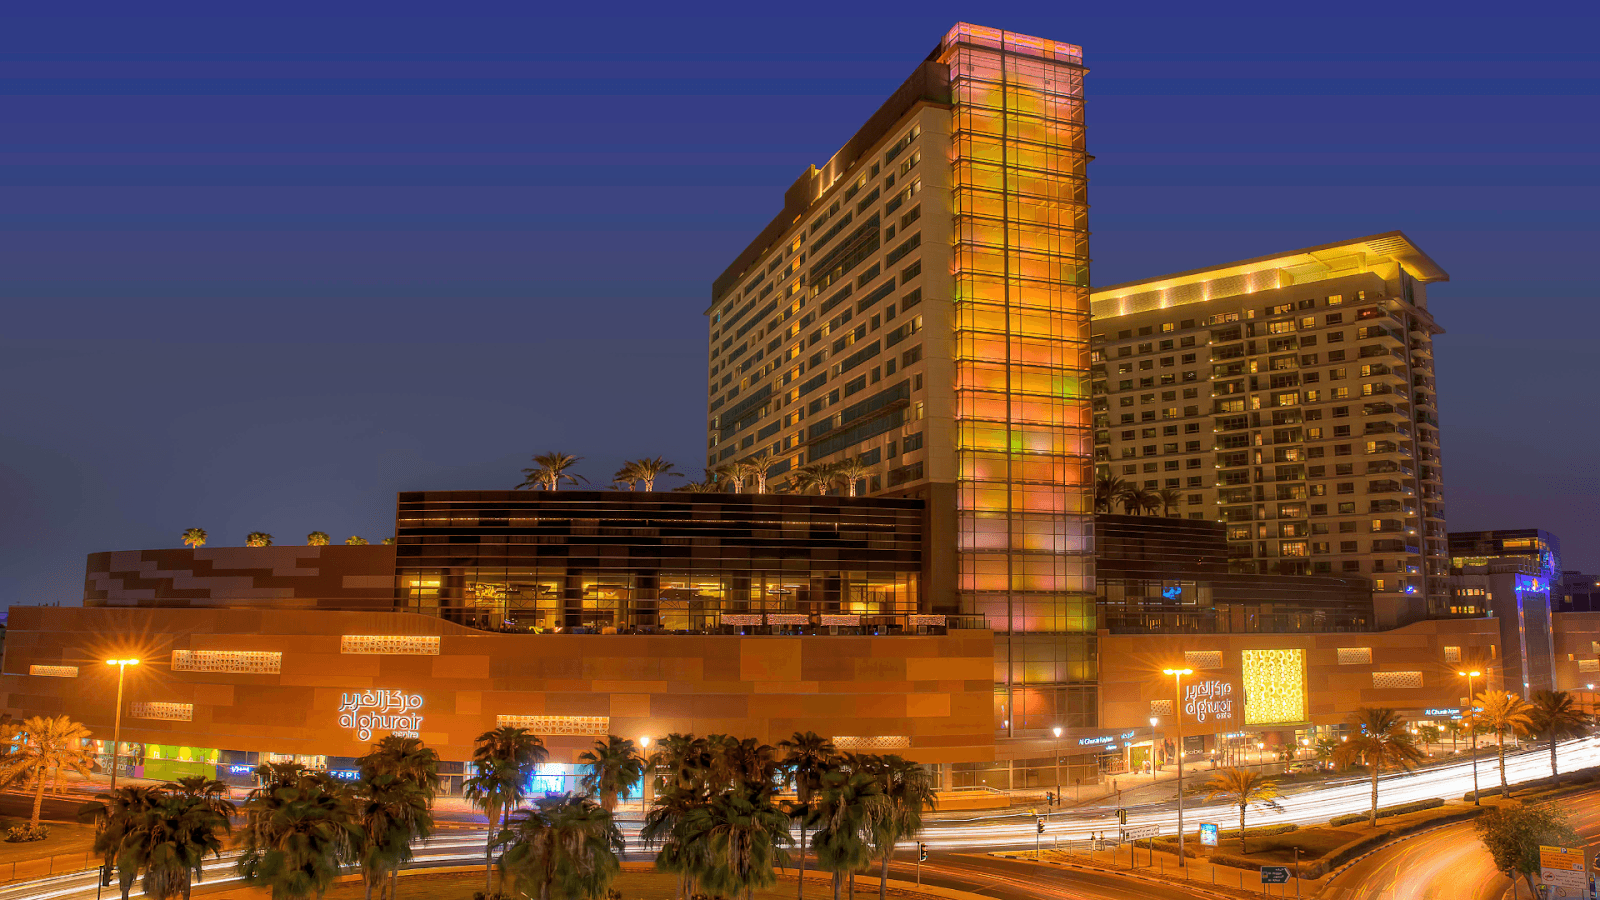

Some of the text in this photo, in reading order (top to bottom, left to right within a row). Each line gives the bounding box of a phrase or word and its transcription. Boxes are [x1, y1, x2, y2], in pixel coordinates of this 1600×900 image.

[338, 689, 423, 714] مركز الغرير
[338, 710, 423, 741] al ghurair
